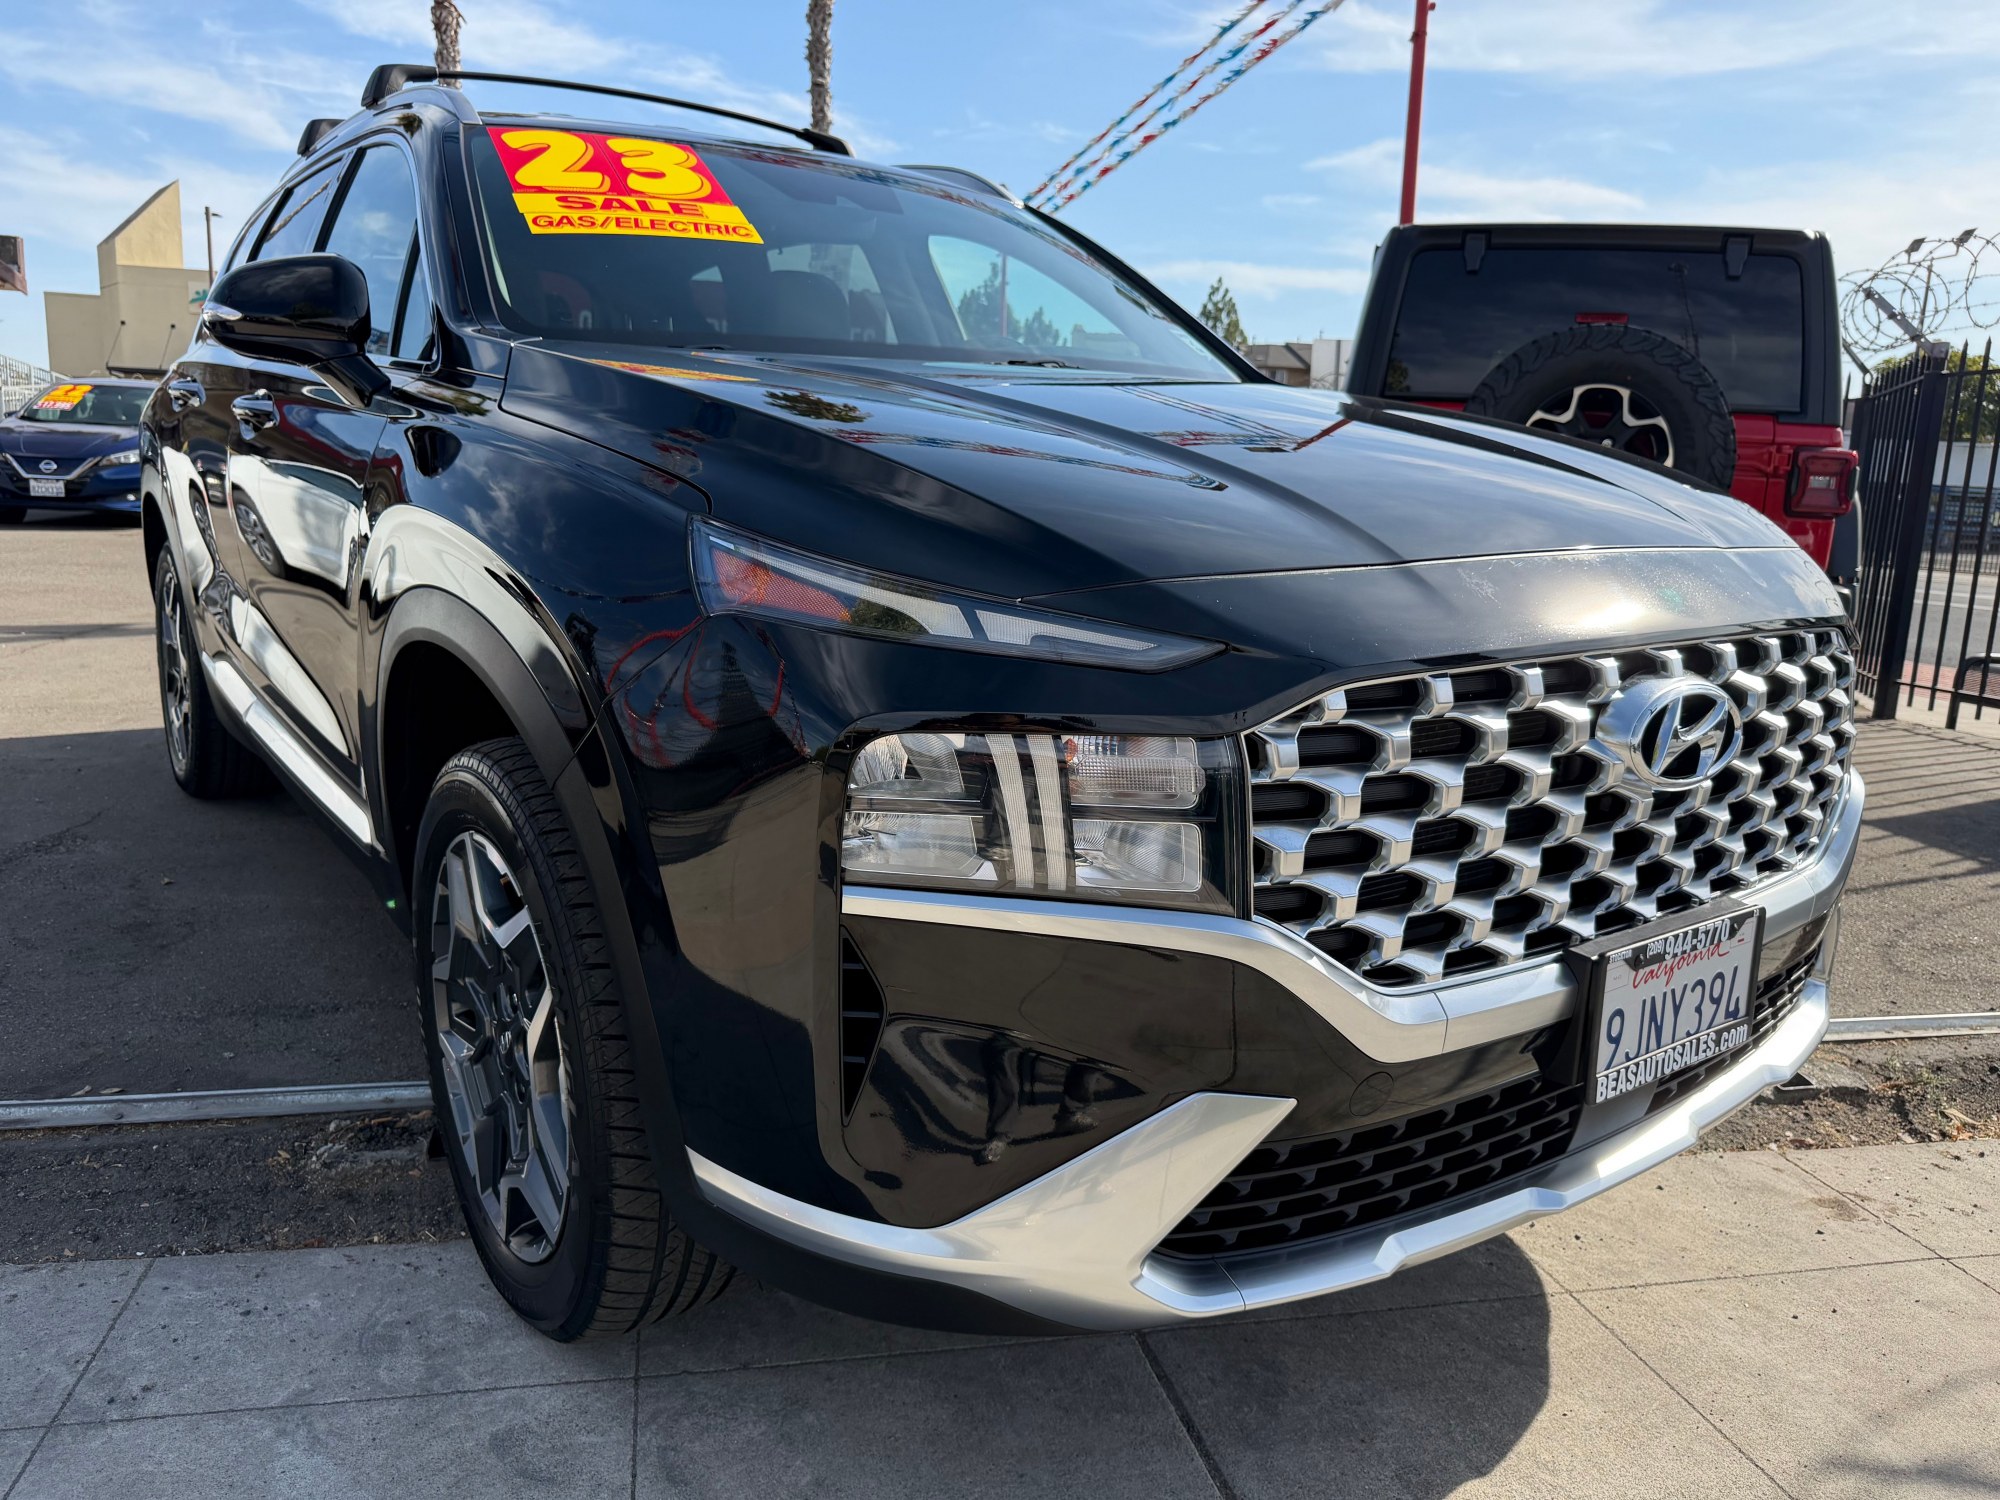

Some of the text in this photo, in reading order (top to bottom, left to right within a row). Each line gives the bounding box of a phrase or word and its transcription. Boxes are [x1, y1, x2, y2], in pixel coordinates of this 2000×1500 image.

[501, 130, 711, 200] 23
[531, 215, 753, 238] GAS/ELECTRIC
[555, 196, 706, 218] SALE
[1647, 939, 1664, 958] (209)
[1665, 918, 1730, 960] 944-5770
[1632, 942, 1729, 989] California
[1606, 965, 1739, 1071] 9JNY394
[1596, 1024, 1748, 1103] BEASAUTOSALES.com
